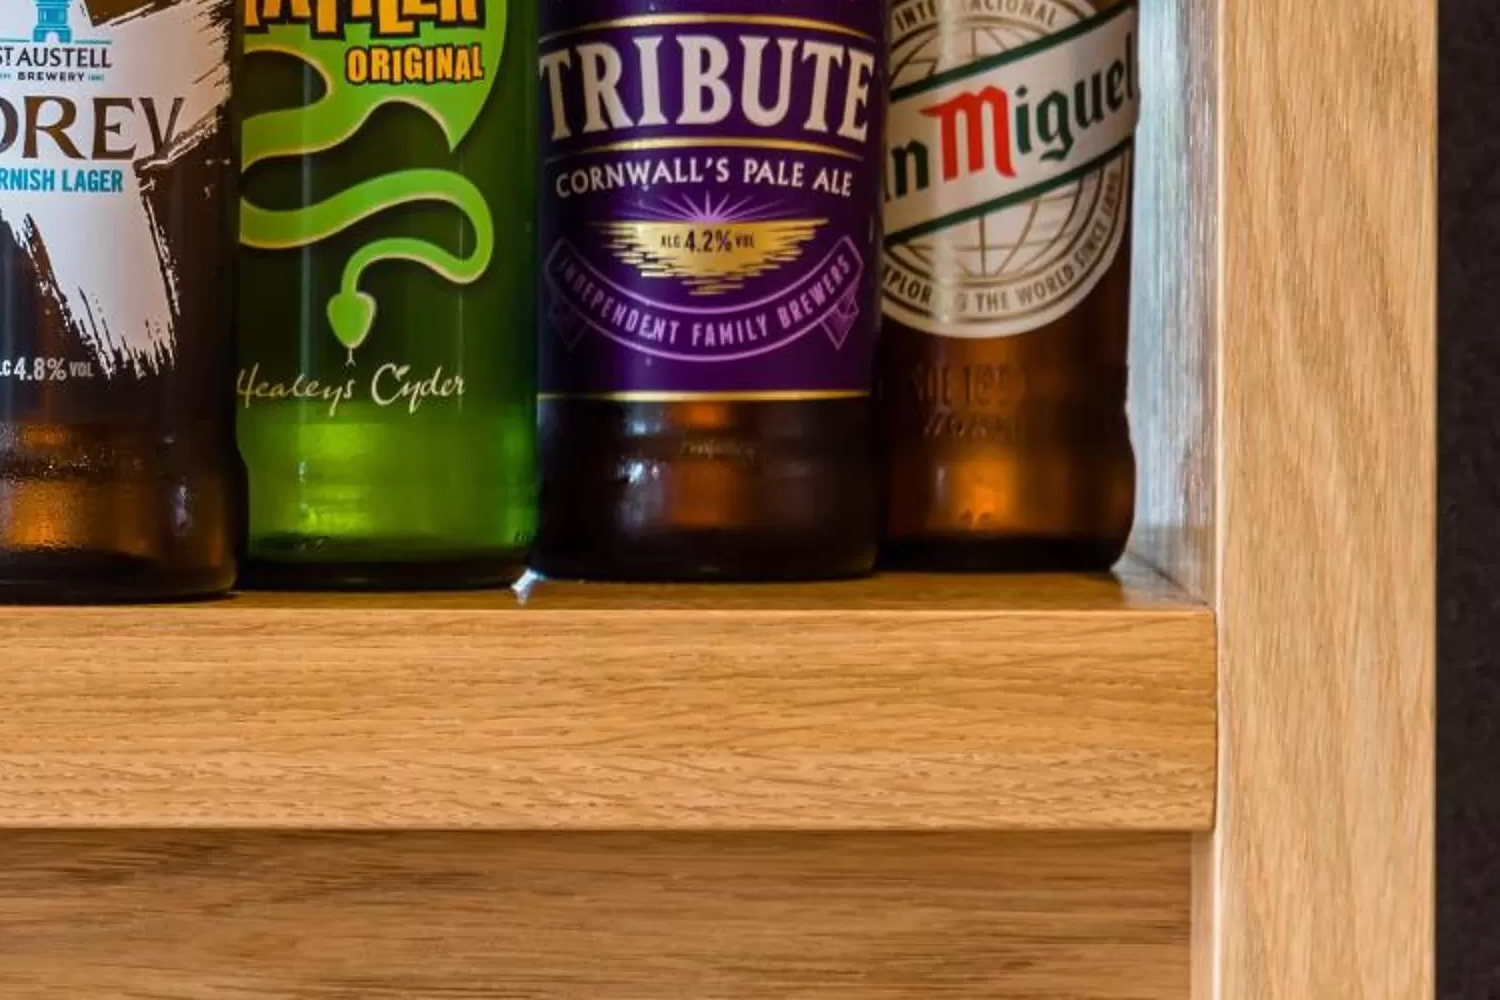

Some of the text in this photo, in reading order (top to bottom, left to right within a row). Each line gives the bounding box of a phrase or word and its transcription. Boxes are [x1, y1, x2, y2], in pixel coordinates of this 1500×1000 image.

[16, 47, 113, 69] AUSTELL
[17, 71, 85, 82] BREWERY
[346, 45, 484, 84] ORIGINAL
[538, 34, 876, 144] TRIBUTE
[919, 31, 1133, 184] Miguel
[61, 168, 124, 194] LAGER
[555, 156, 730, 199] CORNWALL'S
[743, 158, 805, 188] PALE
[812, 167, 854, 198] ALE
[684, 229, 732, 254] 4.2%
[557, 253, 851, 348] INDEPENDENT FAMILY BREWERS
[976, 291, 1010, 314] THE
[1013, 266, 1075, 305] WORLD
[13, 356, 68, 382] 4.8%
[68, 360, 95, 378] VOL
[371, 362, 466, 415] Cyder
